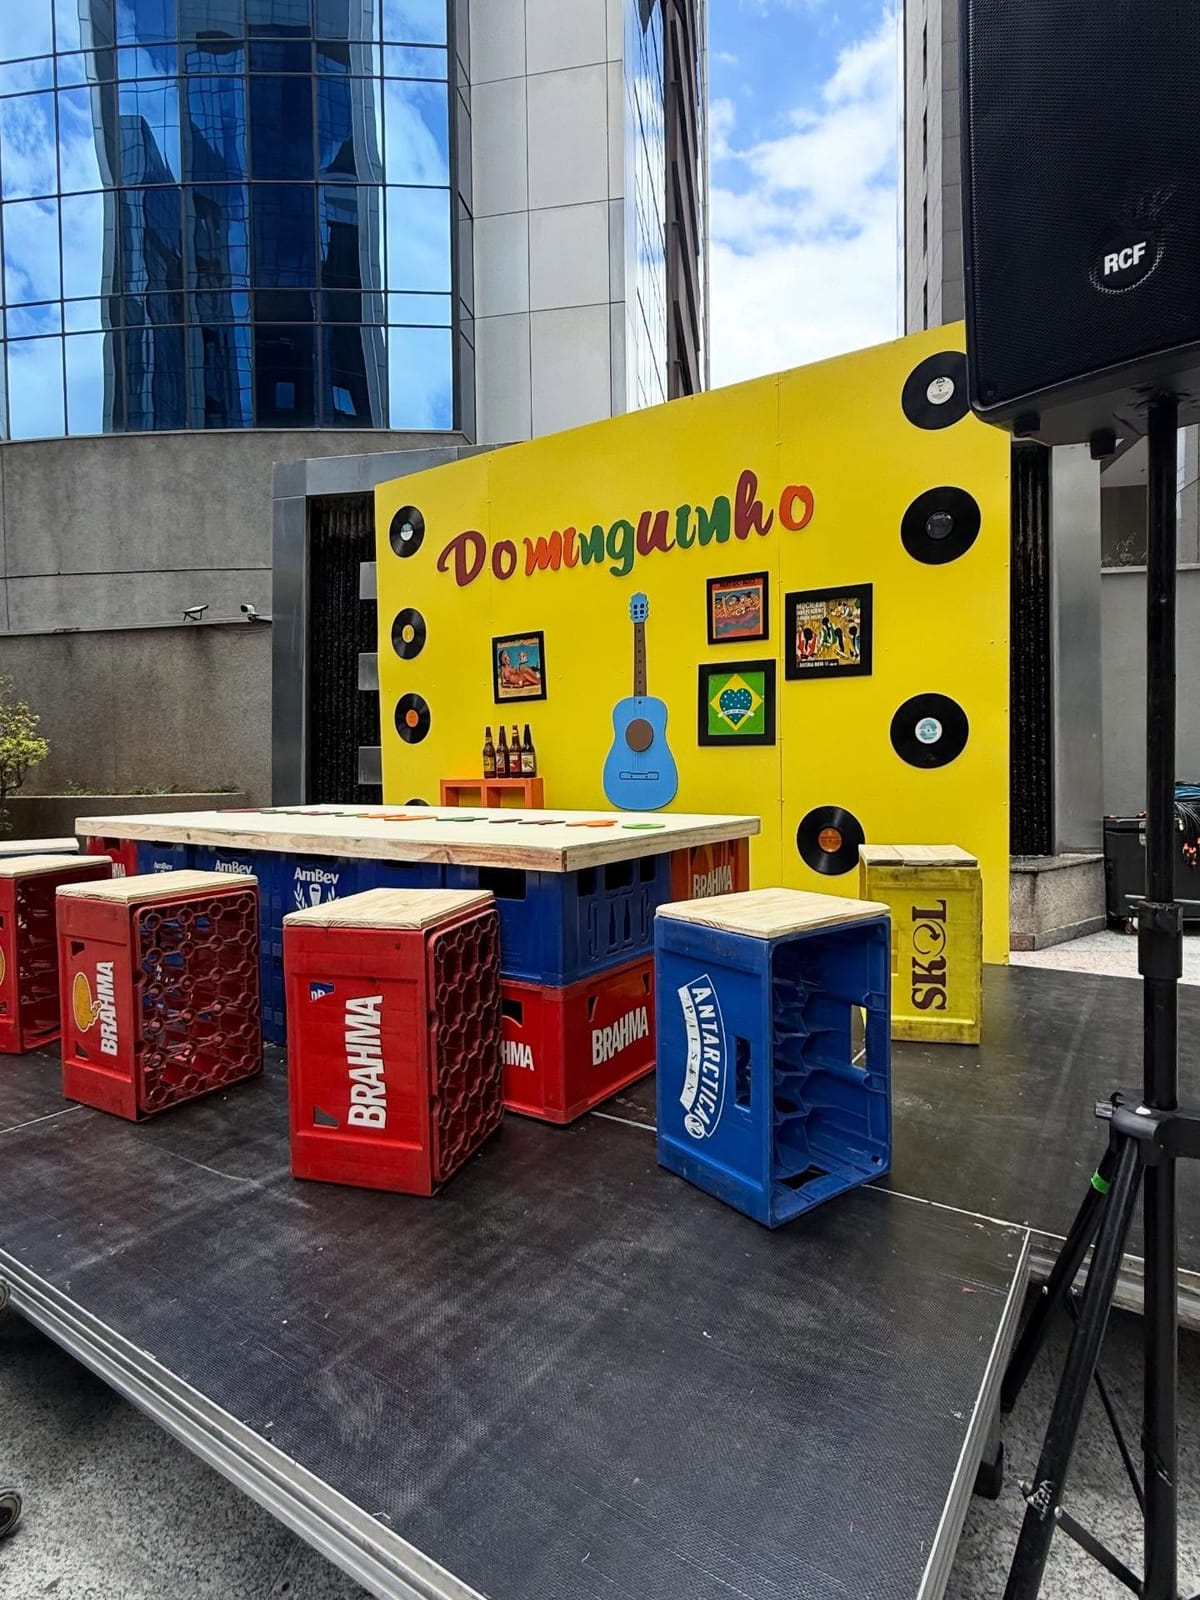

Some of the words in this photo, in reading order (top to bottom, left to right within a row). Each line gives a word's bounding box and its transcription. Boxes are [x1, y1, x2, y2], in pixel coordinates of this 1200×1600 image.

[1103, 241, 1147, 276] RCF
[436, 469, 815, 587] Dominguinho
[215, 859, 253, 875] AmBev
[293, 867, 340, 885] AmBev
[693, 865, 734, 898] BRAHMA
[911, 899, 948, 1011] SKOL
[96, 961, 118, 1057] BRAHMA
[592, 1005, 650, 1066] BRAHMA
[345, 994, 388, 1130] BRAHMA
[691, 985, 722, 1126] ANTARCTICA
